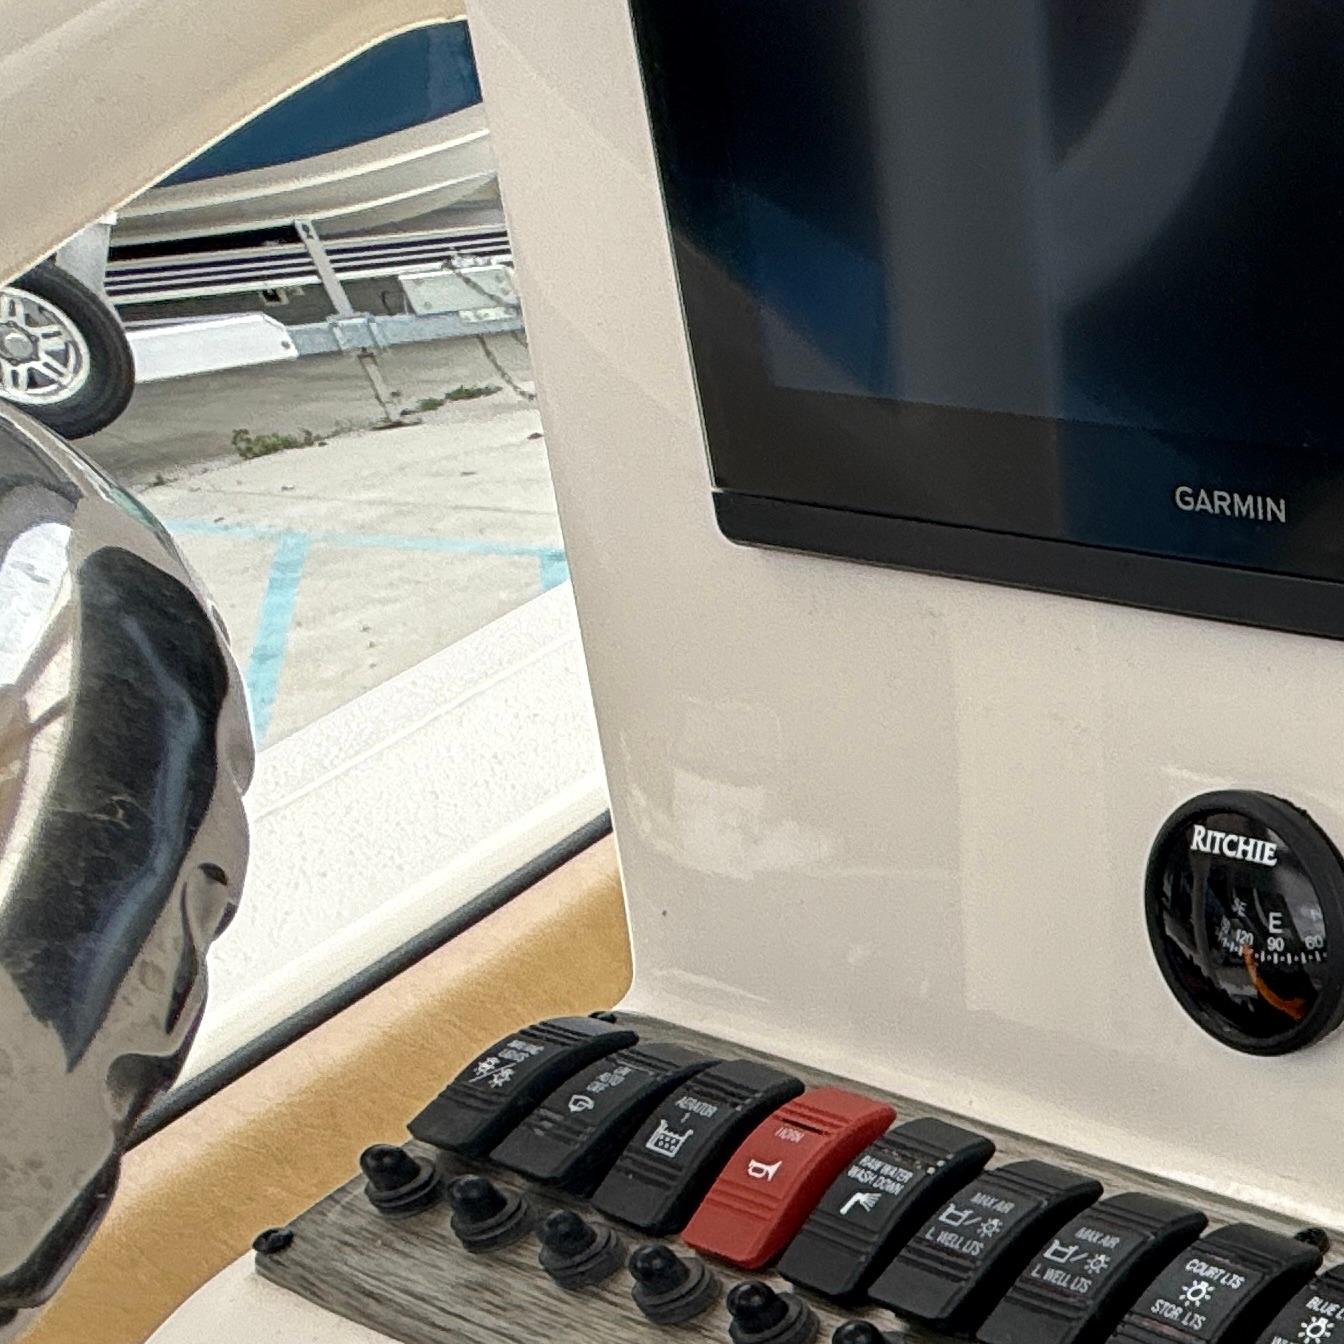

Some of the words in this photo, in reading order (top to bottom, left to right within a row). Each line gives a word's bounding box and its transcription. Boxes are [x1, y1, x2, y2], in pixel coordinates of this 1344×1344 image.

[1175, 485, 1287, 524] GARMIN
[1190, 824, 1277, 867] RITCHIE
[1268, 911, 1283, 934] E
[1266, 936, 1285, 952] 90
[1185, 1258, 1221, 1283] COURT
[1219, 1271, 1245, 1290] LTS
[1305, 1296, 1341, 1316] BLUE
[1181, 1311, 1207, 1331] LTS
